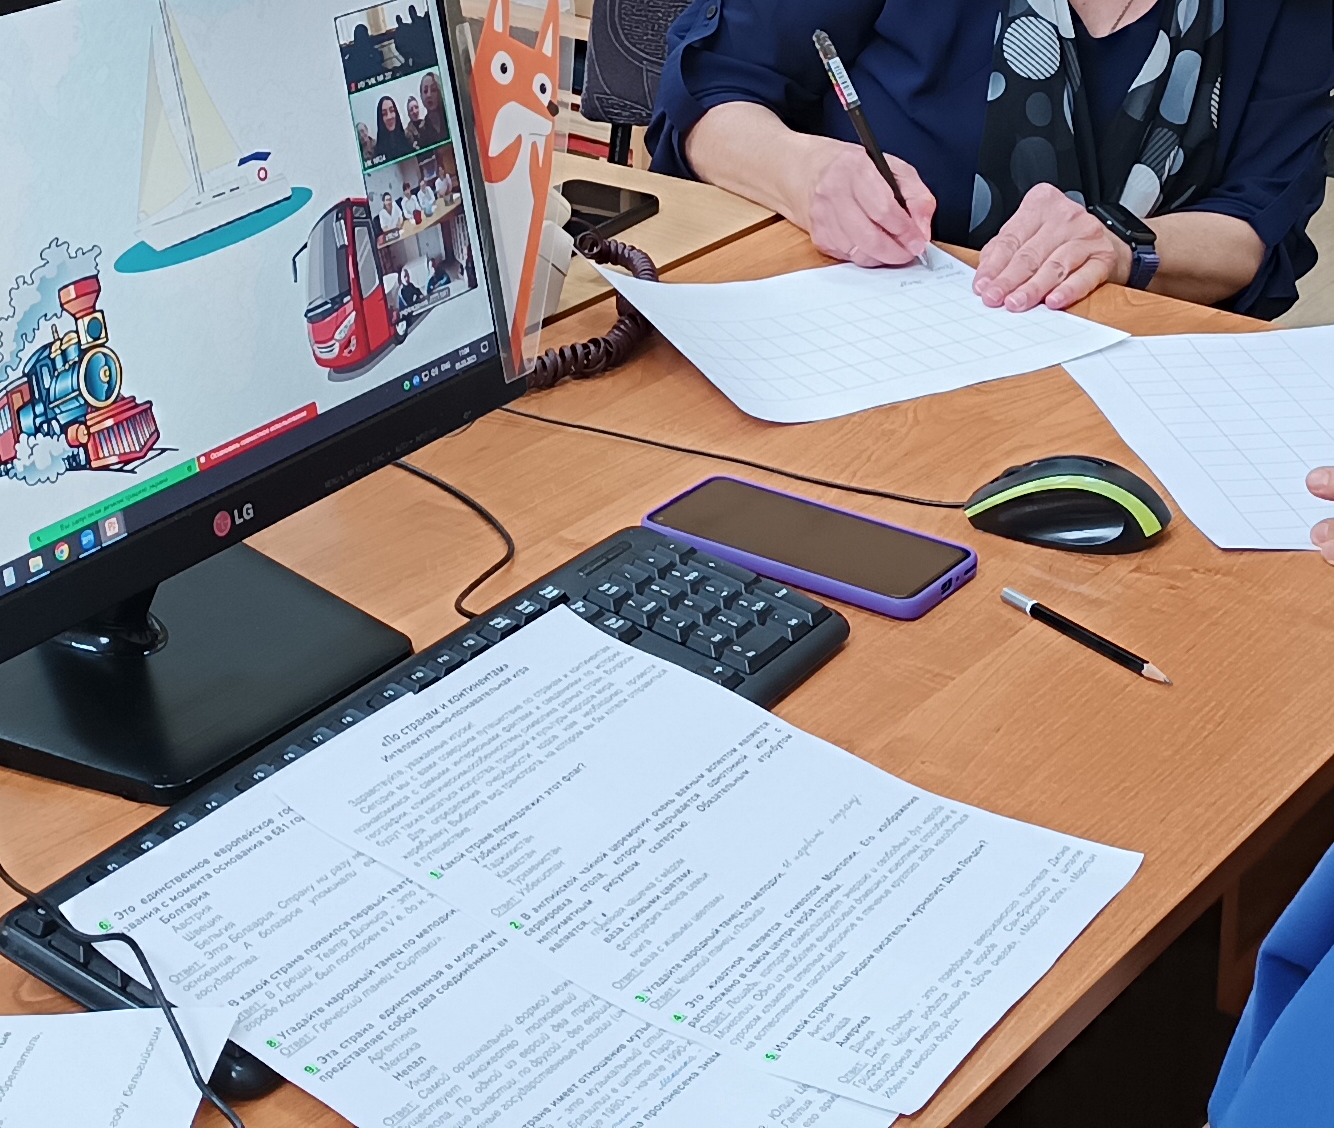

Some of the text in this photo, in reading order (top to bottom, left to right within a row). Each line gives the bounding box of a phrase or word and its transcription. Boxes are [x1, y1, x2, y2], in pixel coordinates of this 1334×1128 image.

[233, 503, 255, 526] LG
[399, 707, 440, 735] странам
[439, 702, 449, 710] и
[464, 831, 495, 854] стране
[530, 875, 579, 914] английской
[650, 797, 676, 817] очень
[112, 904, 136, 921] Это
[139, 857, 210, 905] единственное
[212, 817, 275, 857] европейское
[168, 872, 213, 903] момента
[212, 838, 265, 874] основания
[523, 897, 573, 937] сервировка
[612, 837, 647, 865] который
[158, 890, 210, 925] Болгария
[170, 904, 213, 934] Австрия
[181, 913, 223, 942] Швеция
[192, 920, 236, 950] Бельгия
[239, 894, 388, 1001] какой стране появился первый
[276, 937, 416, 1040] Угадайте народный танец по
[315, 1048, 339, 1065] Эта
[338, 1022, 375, 1049] страна
[378, 969, 444, 1020] единственная
[452, 942, 479, 963] мире
[318, 1029, 388, 1082] представляет
[386, 1006, 418, 1032] собой
[416, 992, 437, 1010] два
[366, 1026, 418, 1065] Аргентина
[377, 1041, 421, 1072] Мексика
[392, 1055, 427, 1081] Непал
